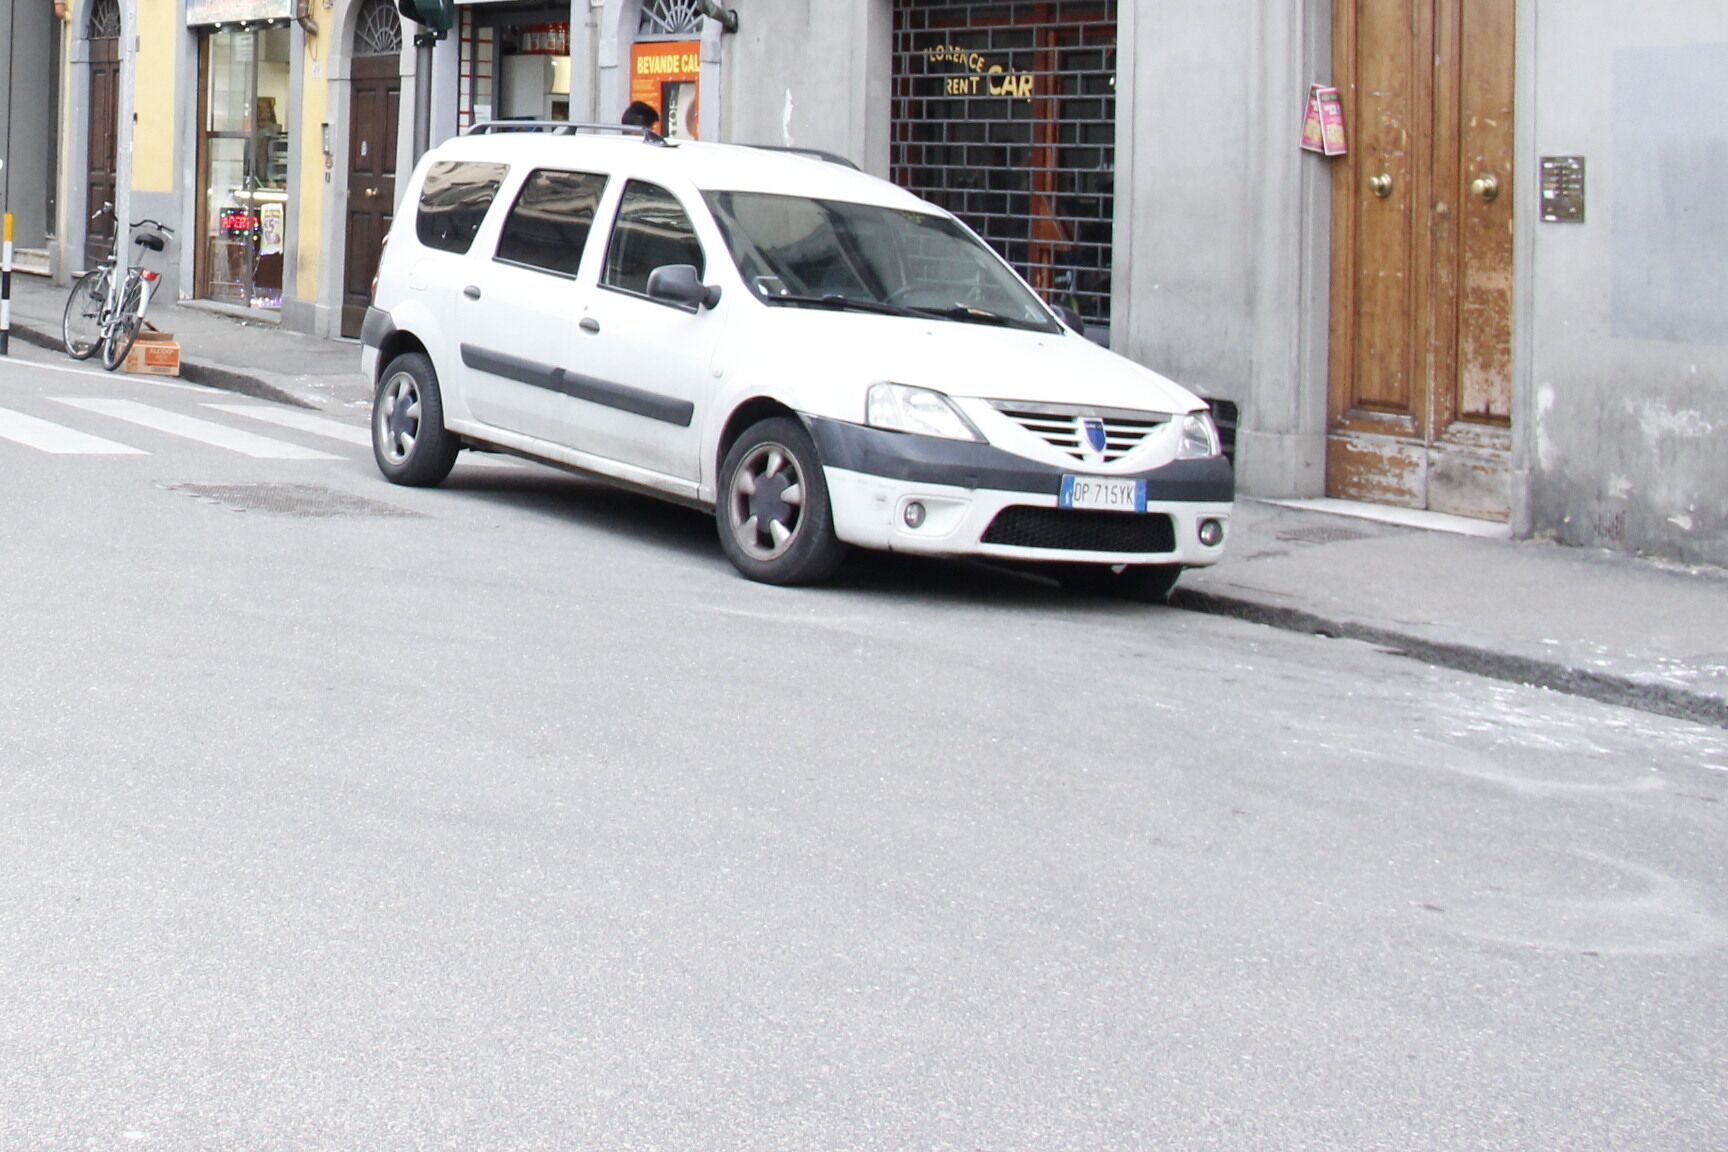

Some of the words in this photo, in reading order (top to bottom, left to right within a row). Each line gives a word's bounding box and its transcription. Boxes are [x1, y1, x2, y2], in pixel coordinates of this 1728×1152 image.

[637, 54, 679, 75] BEVANDE
[681, 53, 701, 74] CAL
[946, 76, 980, 95] RENT
[988, 64, 1034, 98] CAR
[1074, 482, 1090, 502] DP
[1094, 484, 1134, 504] 715YK
